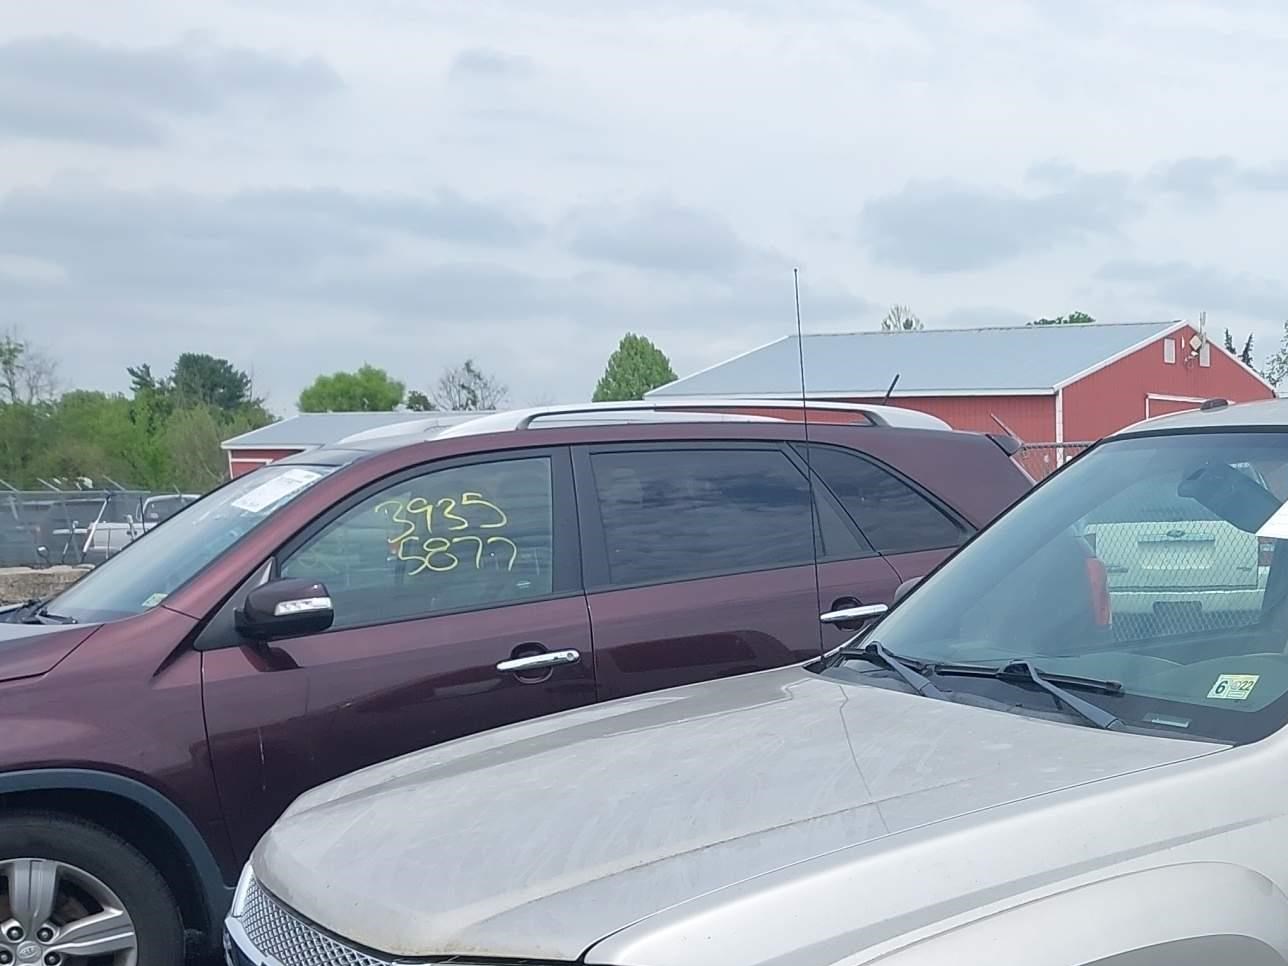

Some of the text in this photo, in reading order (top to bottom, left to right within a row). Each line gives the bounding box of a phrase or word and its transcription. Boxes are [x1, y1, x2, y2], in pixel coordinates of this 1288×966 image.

[374, 490, 508, 544] 3935
[397, 535, 518, 576] 5877
[1214, 680, 1255, 695] 6 22
